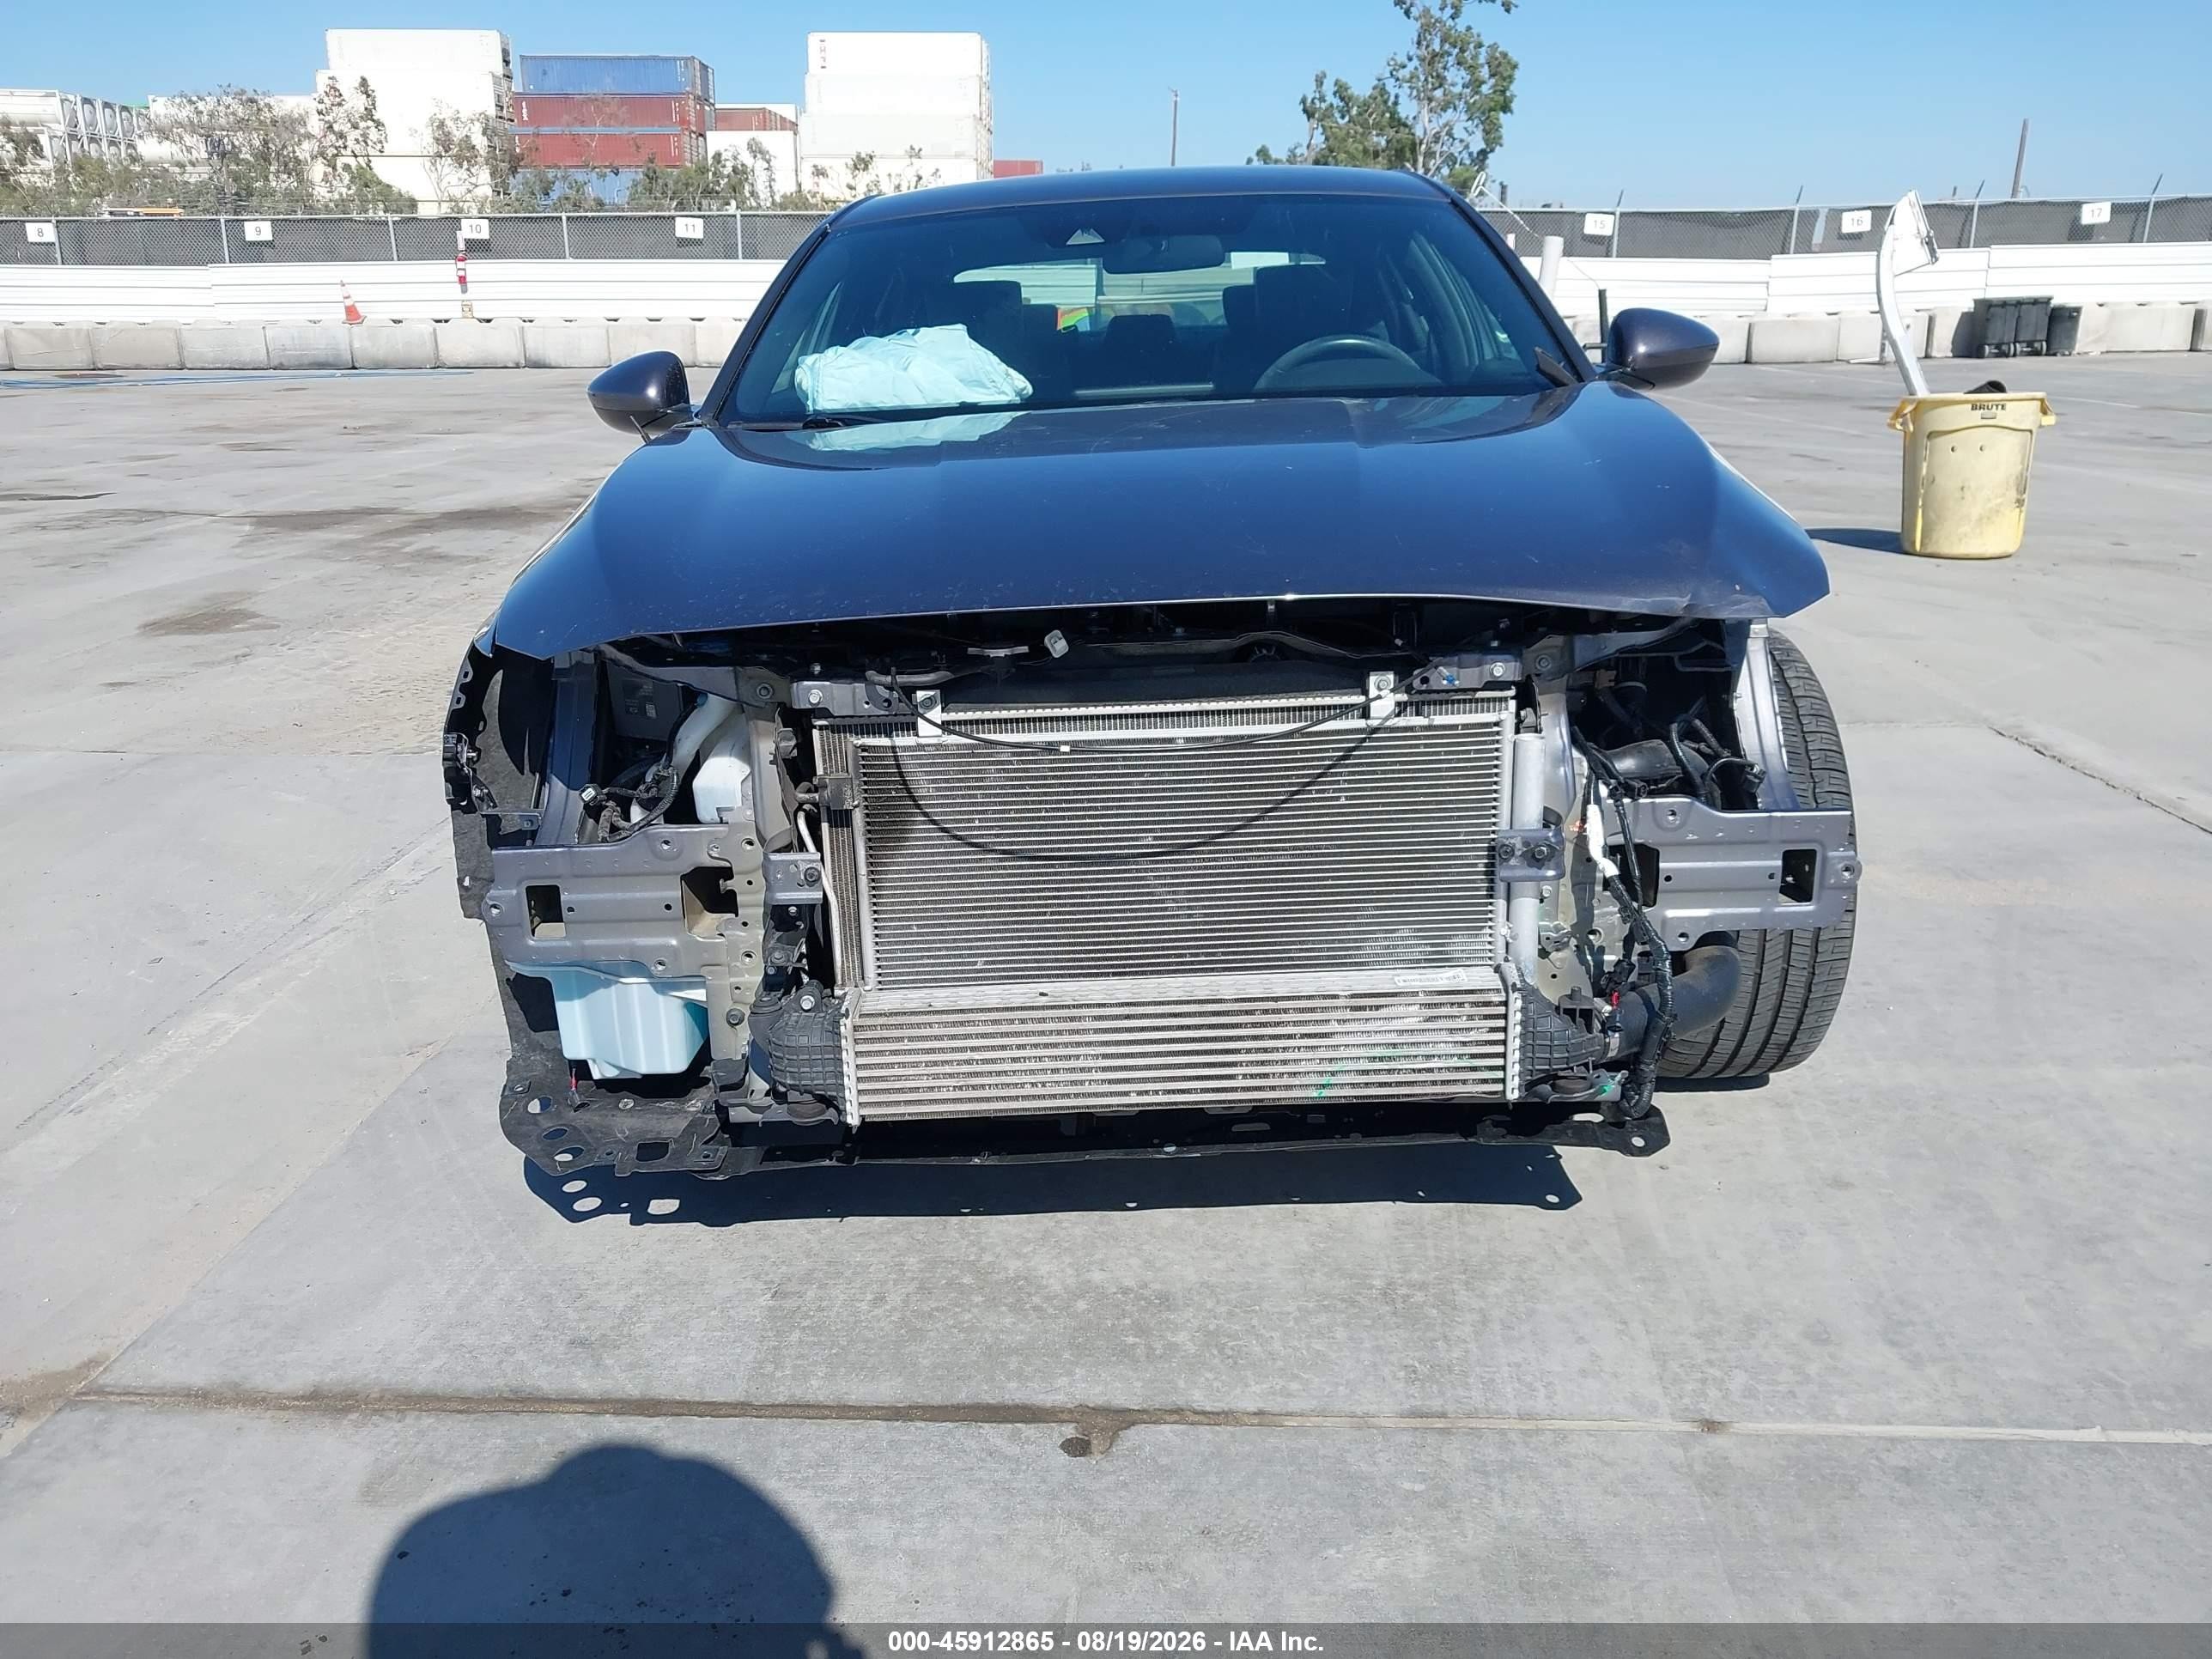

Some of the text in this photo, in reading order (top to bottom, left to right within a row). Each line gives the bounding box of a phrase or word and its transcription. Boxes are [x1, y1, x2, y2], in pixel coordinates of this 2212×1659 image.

[2090, 208, 2102, 218] 17
[1594, 219, 1606, 229] 15
[1850, 217, 1863, 227] 16
[37, 228, 45, 238] 8
[254, 227, 262, 236] 9
[469, 224, 482, 234] 10
[684, 223, 696, 234] 11
[1971, 403, 2007, 411] BRUTE
